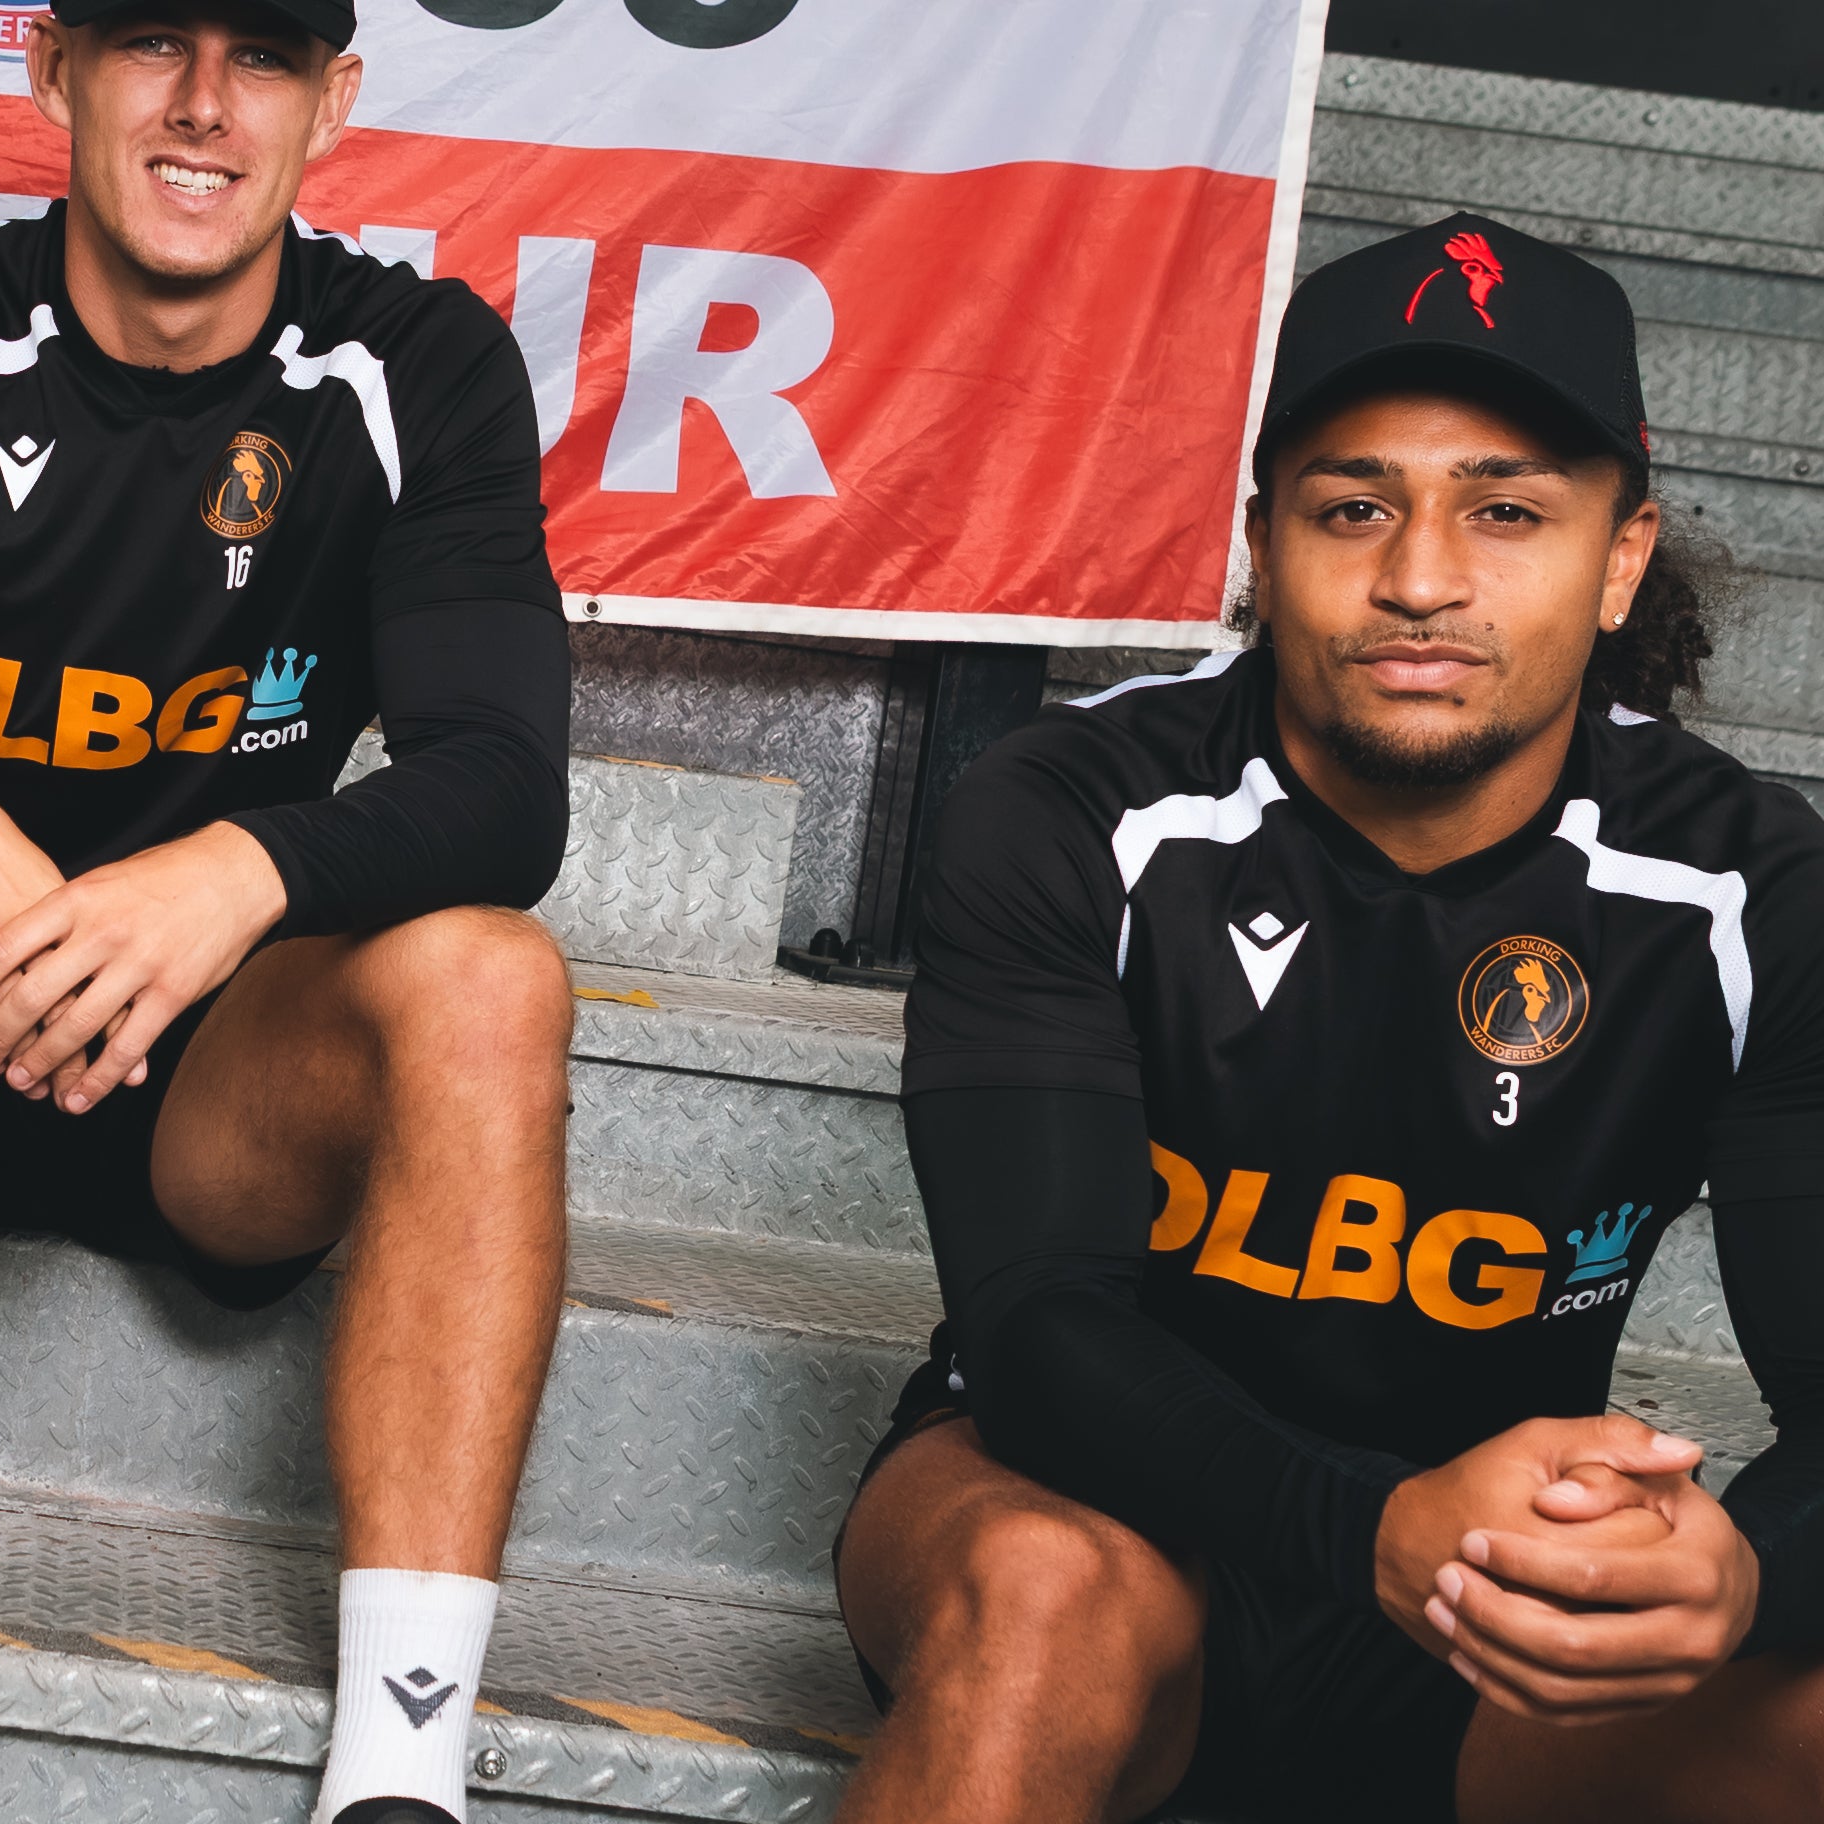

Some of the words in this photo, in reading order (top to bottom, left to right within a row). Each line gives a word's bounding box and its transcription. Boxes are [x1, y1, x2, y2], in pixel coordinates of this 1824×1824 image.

[229, 434, 269, 450] RKING
[206, 510, 264, 536] WANDERERS
[263, 510, 276, 525] FC
[224, 544, 254, 590] 16
[230, 717, 308, 755] .com
[1499, 939, 1562, 963] DORKING
[1469, 1025, 1546, 1061] WANDERERS
[1545, 1037, 1563, 1054] FC
[1492, 1071, 1520, 1127] 3
[1542, 1275, 1631, 1322] .com
